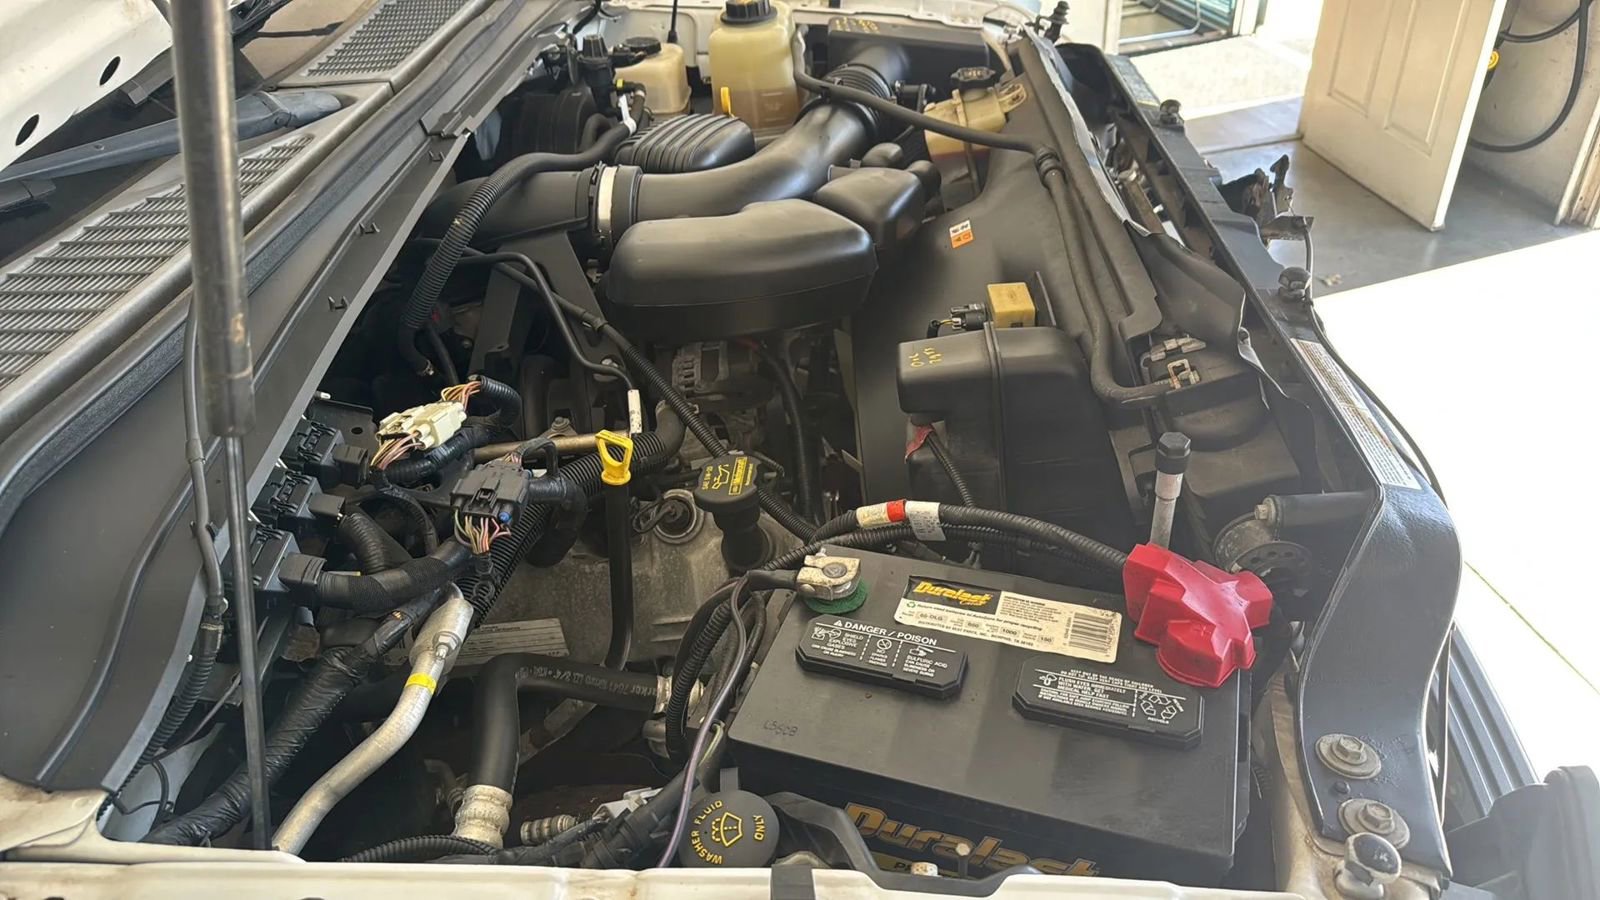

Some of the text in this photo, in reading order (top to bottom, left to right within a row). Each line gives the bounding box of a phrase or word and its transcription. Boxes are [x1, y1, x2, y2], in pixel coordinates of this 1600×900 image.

[844, 620, 886, 635] DANGER
[896, 631, 937, 645] POISON
[691, 800, 766, 865] WASHER FLUID ONLY
